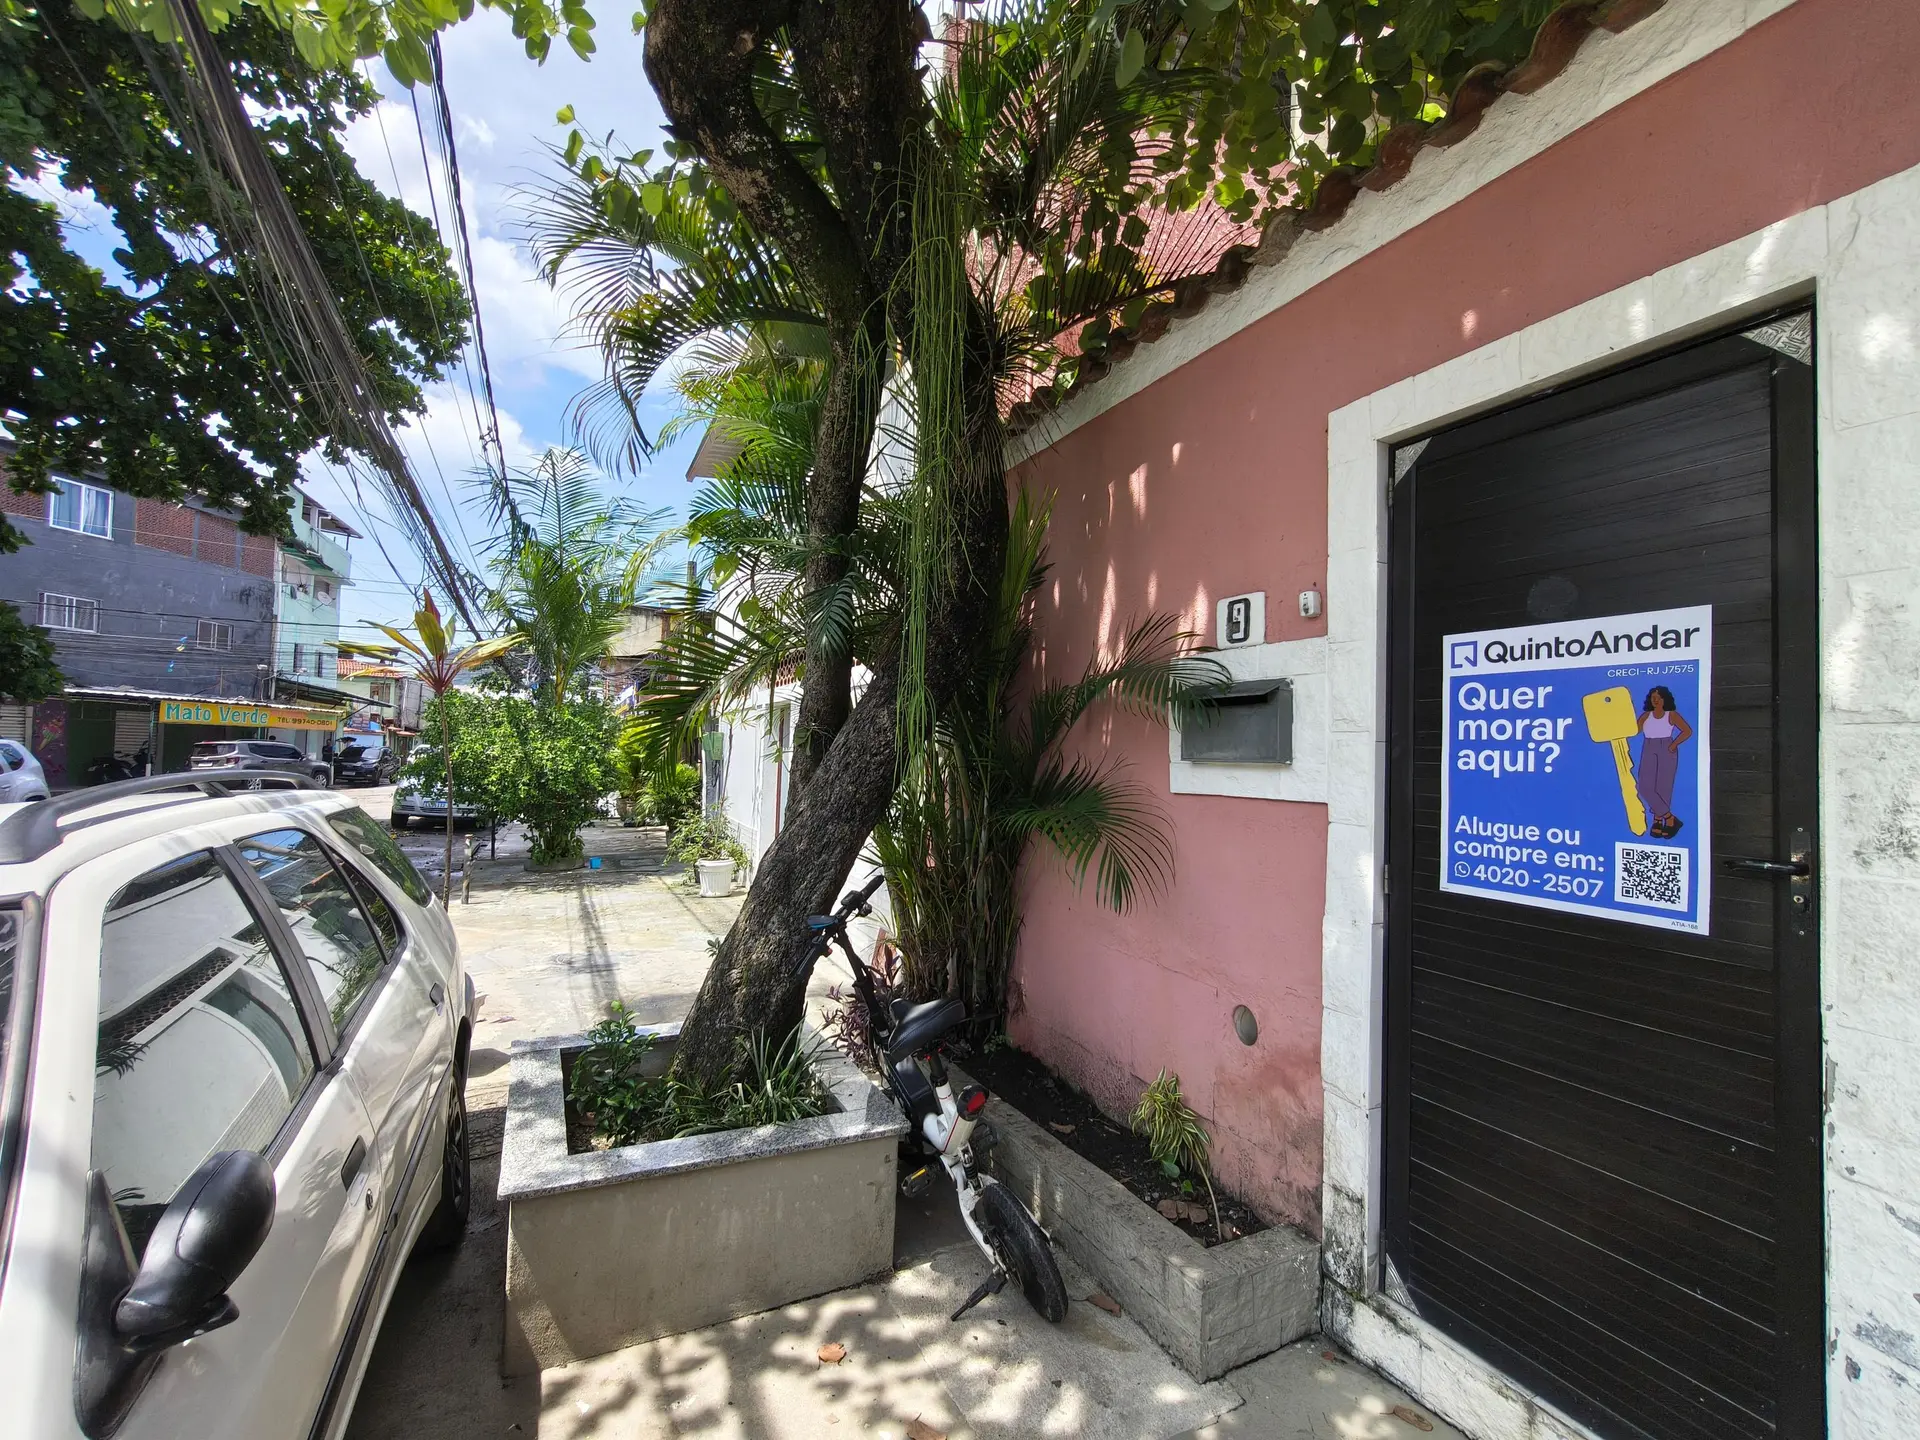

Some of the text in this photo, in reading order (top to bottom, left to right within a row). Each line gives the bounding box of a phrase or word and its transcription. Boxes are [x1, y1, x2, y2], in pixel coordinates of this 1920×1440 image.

[1226, 598, 1251, 644] 9
[1484, 625, 1700, 663] QuintoAndar
[1607, 664, 1694, 678] CRECI-RJ J7575
[1457, 682, 1553, 711] Quer
[165, 703, 269, 724] Mato Verde
[1457, 718, 1573, 741] morar
[1457, 742, 1561, 778] aqui?
[1455, 815, 1581, 846] Alugue ou
[1454, 840, 1605, 872] compre em:
